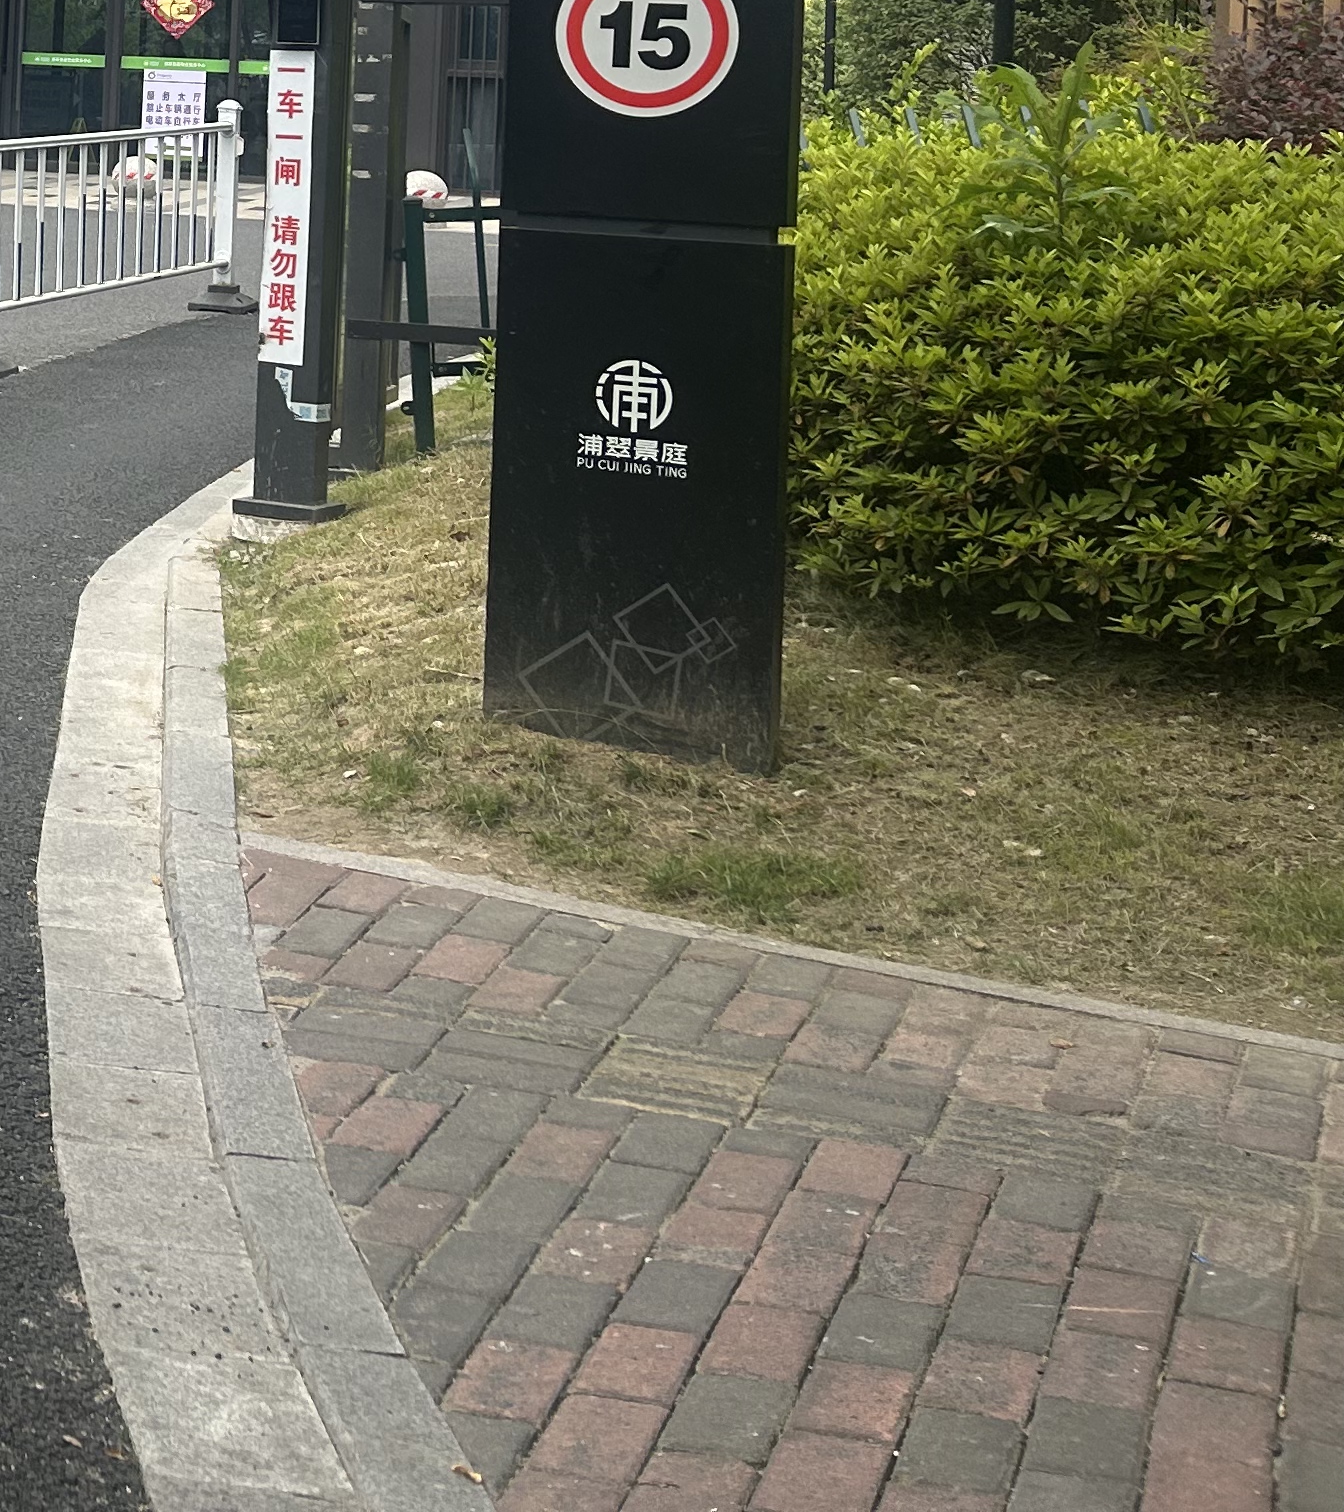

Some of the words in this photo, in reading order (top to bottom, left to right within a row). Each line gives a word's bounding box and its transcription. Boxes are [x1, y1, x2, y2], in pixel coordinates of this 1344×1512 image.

[600, 0, 691, 70] 15
[145, 103, 202, 115] 禁止车辆通行
[577, 432, 688, 466] 浦翠景庭
[577, 457, 595, 470] PU
[597, 459, 620, 472] CUI
[624, 461, 652, 476] JING
[657, 464, 687, 479] TING
